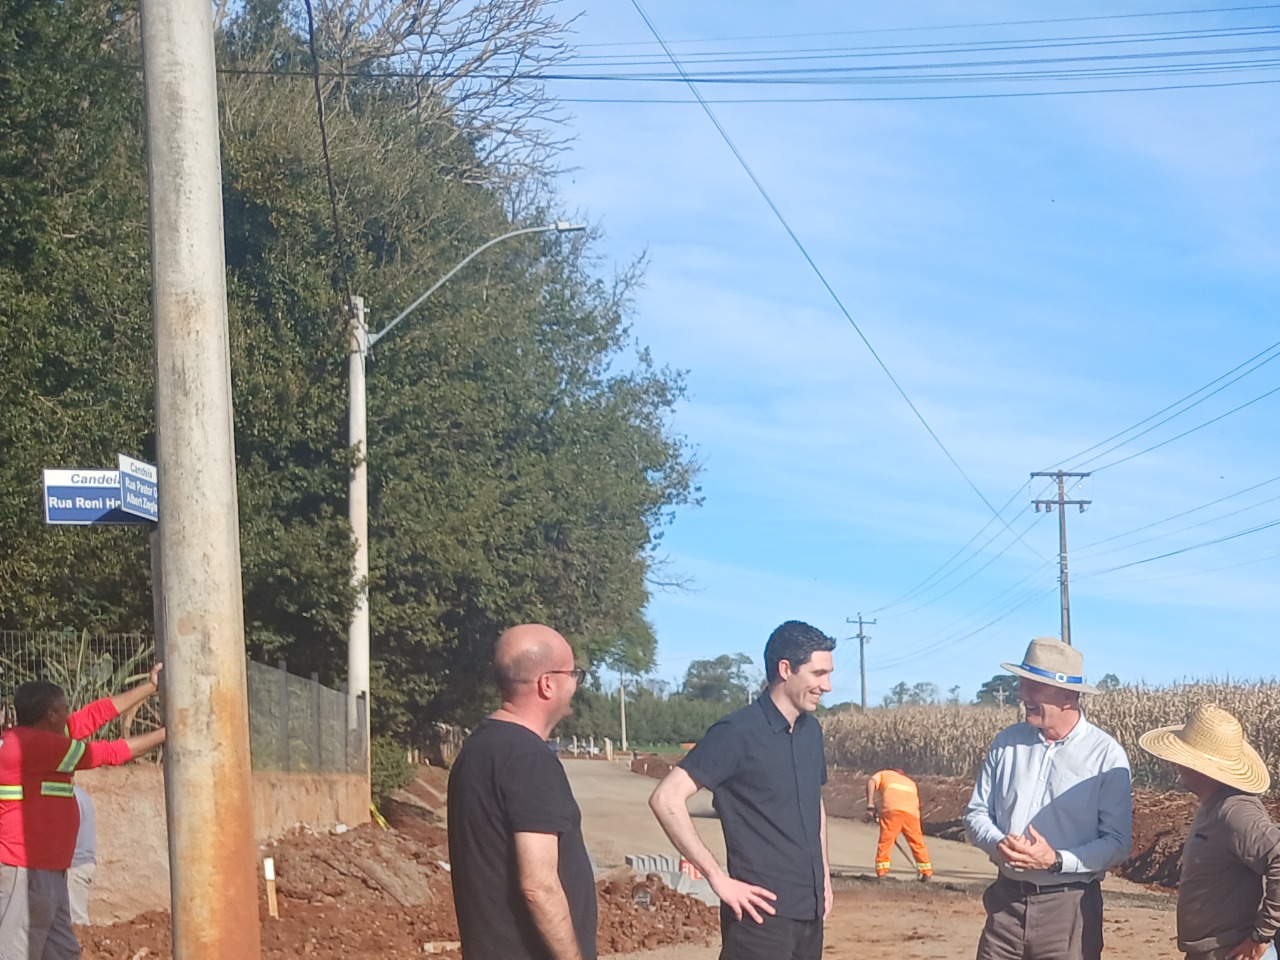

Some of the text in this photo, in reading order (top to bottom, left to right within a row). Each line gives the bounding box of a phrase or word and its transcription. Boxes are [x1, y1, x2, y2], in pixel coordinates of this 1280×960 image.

[130, 462, 153, 479] Candeia
[71, 473, 120, 485] Candei
[48, 496, 73, 509] Rua
